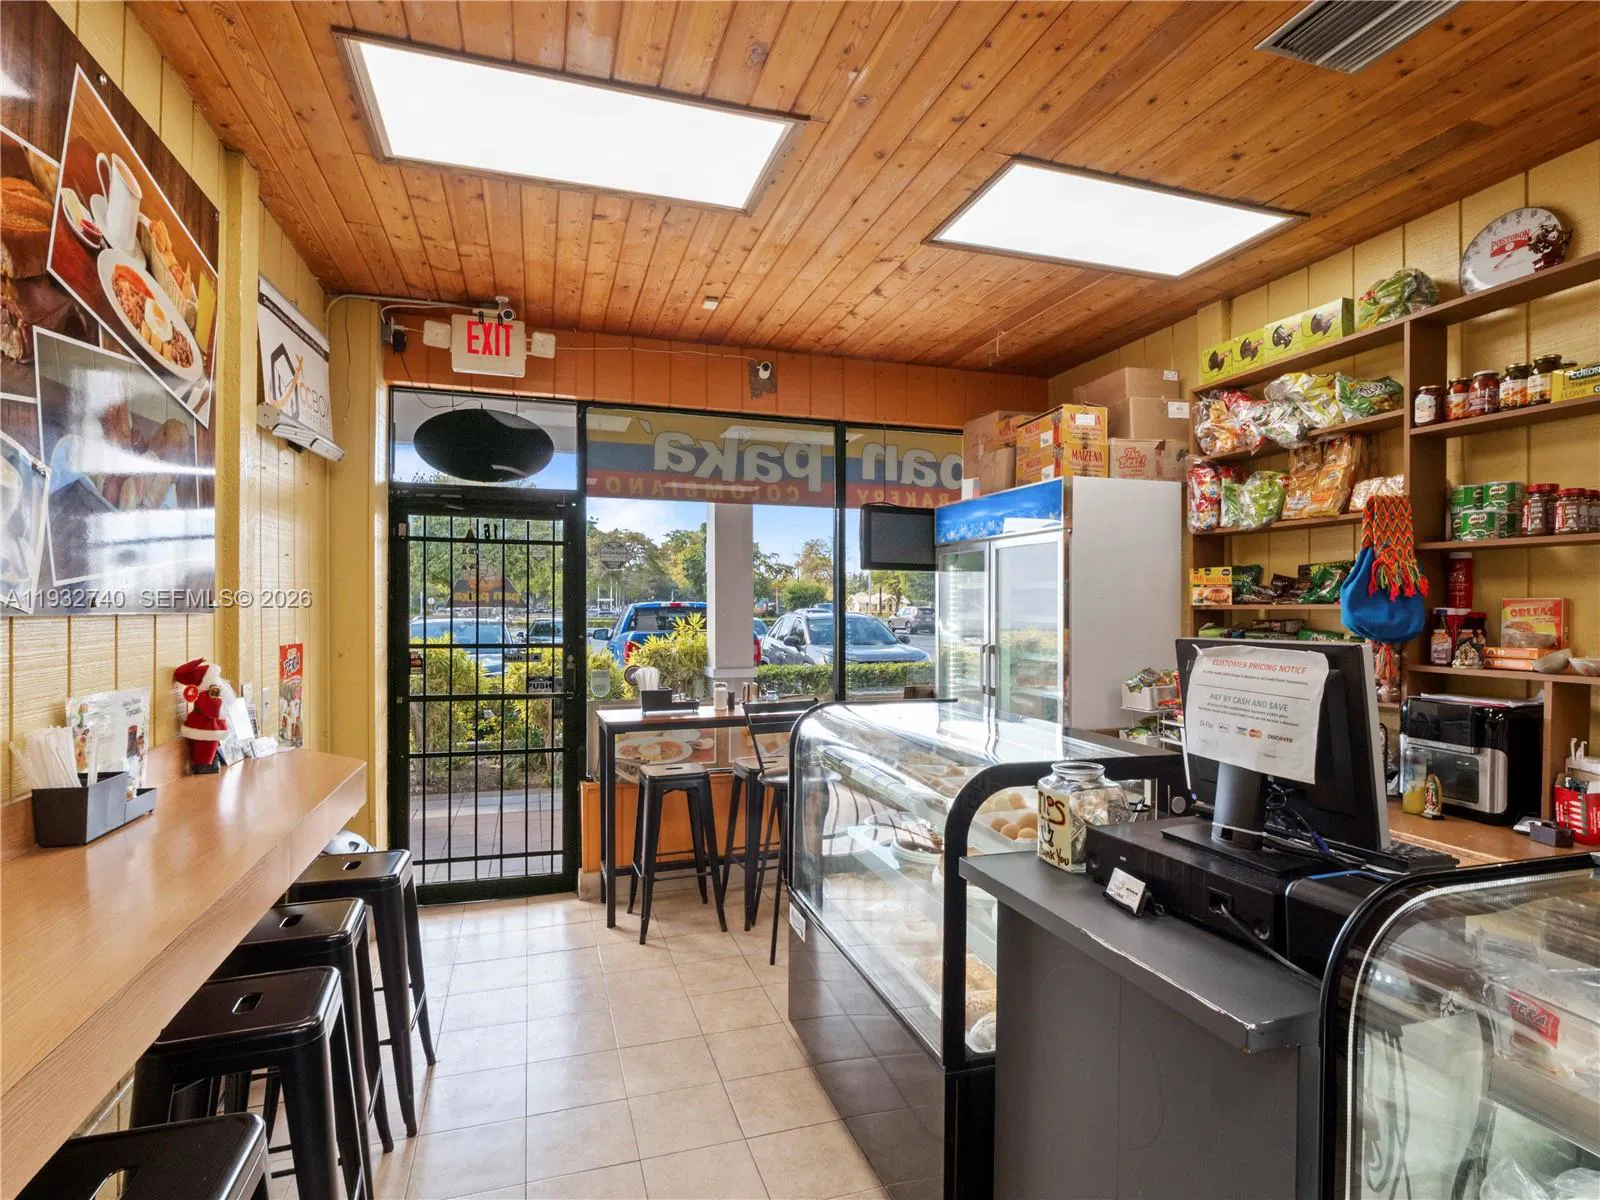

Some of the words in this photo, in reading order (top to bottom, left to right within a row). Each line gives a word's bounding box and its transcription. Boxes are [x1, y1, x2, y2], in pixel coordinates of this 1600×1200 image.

[466, 320, 513, 357] EXIT
[1071, 448, 1103, 463] MAIZENA
[1212, 659, 1248, 669] CUSTOMER
[1248, 662, 1278, 672] PRICING
[1279, 664, 1308, 675] NOTICE
[528, 682, 552, 690] PUSH
[1209, 693, 1222, 702] PAY
[1222, 695, 1232, 703] BY
[1232, 696, 1250, 706] CASH
[1250, 699, 1267, 709] AND
[1268, 702, 1289, 713] SAVE
[1037, 790, 1066, 826] TIPS
